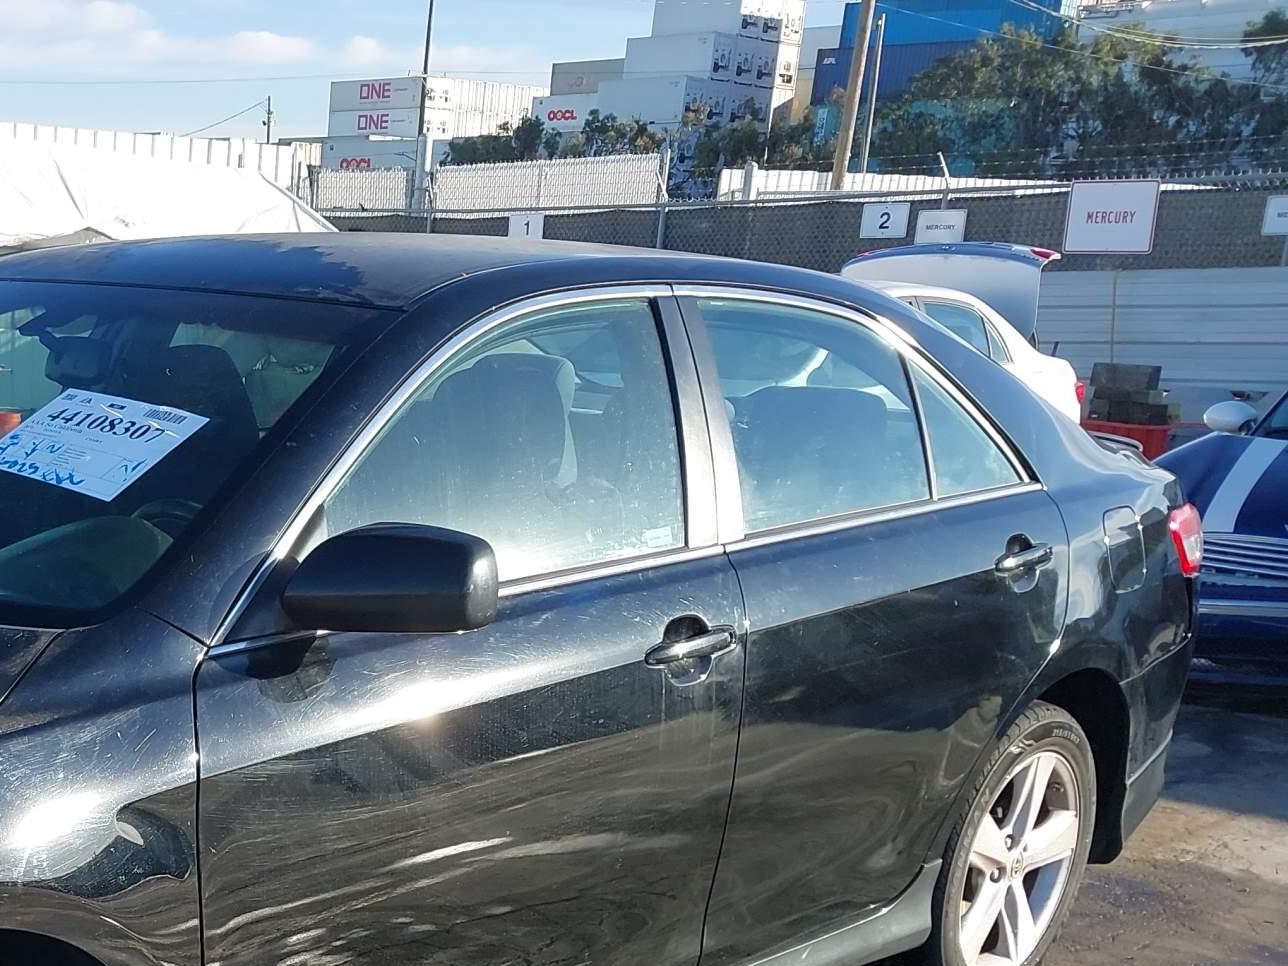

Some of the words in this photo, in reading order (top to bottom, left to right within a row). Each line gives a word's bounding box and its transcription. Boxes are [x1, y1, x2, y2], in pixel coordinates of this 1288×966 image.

[359, 82, 392, 100] ONE
[357, 113, 389, 130] ONE
[547, 109, 578, 121] OOCL
[878, 211, 891, 230] 2
[1085, 210, 1137, 225] MERCURY
[523, 220, 530, 236] 1
[47, 406, 166, 444] 44108307
